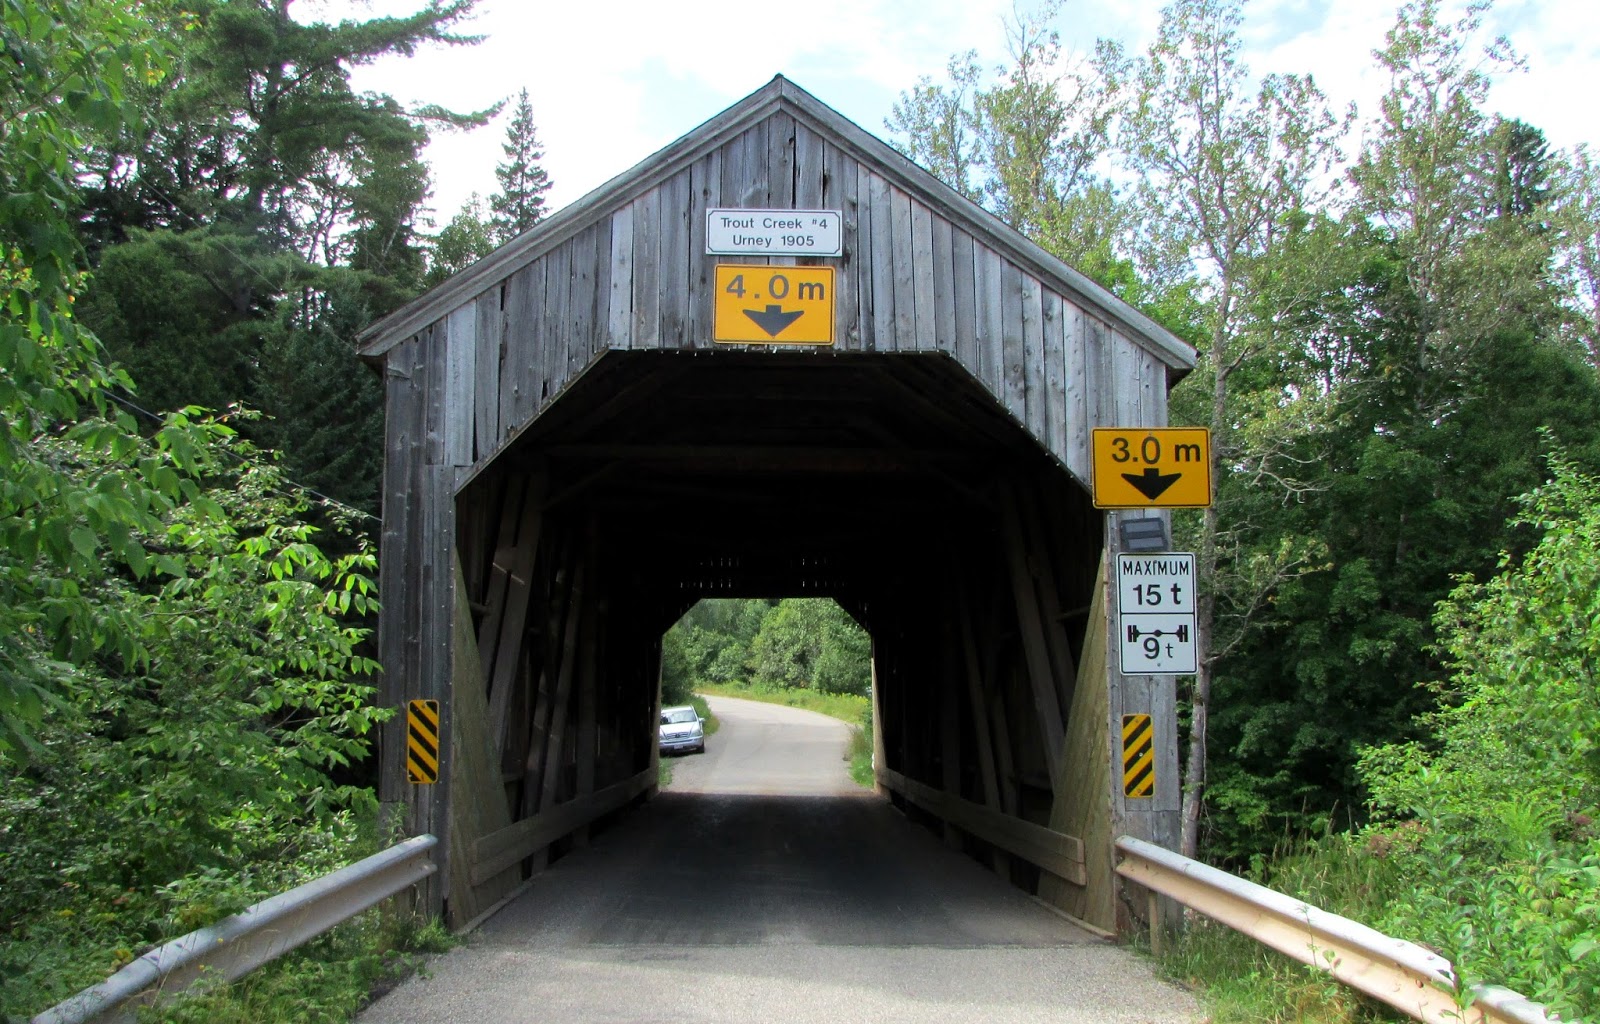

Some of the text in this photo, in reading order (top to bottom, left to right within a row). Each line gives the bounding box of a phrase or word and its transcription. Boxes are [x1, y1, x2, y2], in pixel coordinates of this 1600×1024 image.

[720, 217, 755, 229] Trout
[763, 217, 803, 229] Creek
[732, 234, 815, 248] Urney 1905
[1111, 436, 1201, 464] 3.0 m
[1123, 560, 1190, 576] MAXIMUM
[1132, 582, 1182, 606] 15 t
[1143, 637, 1174, 660] 9 t
